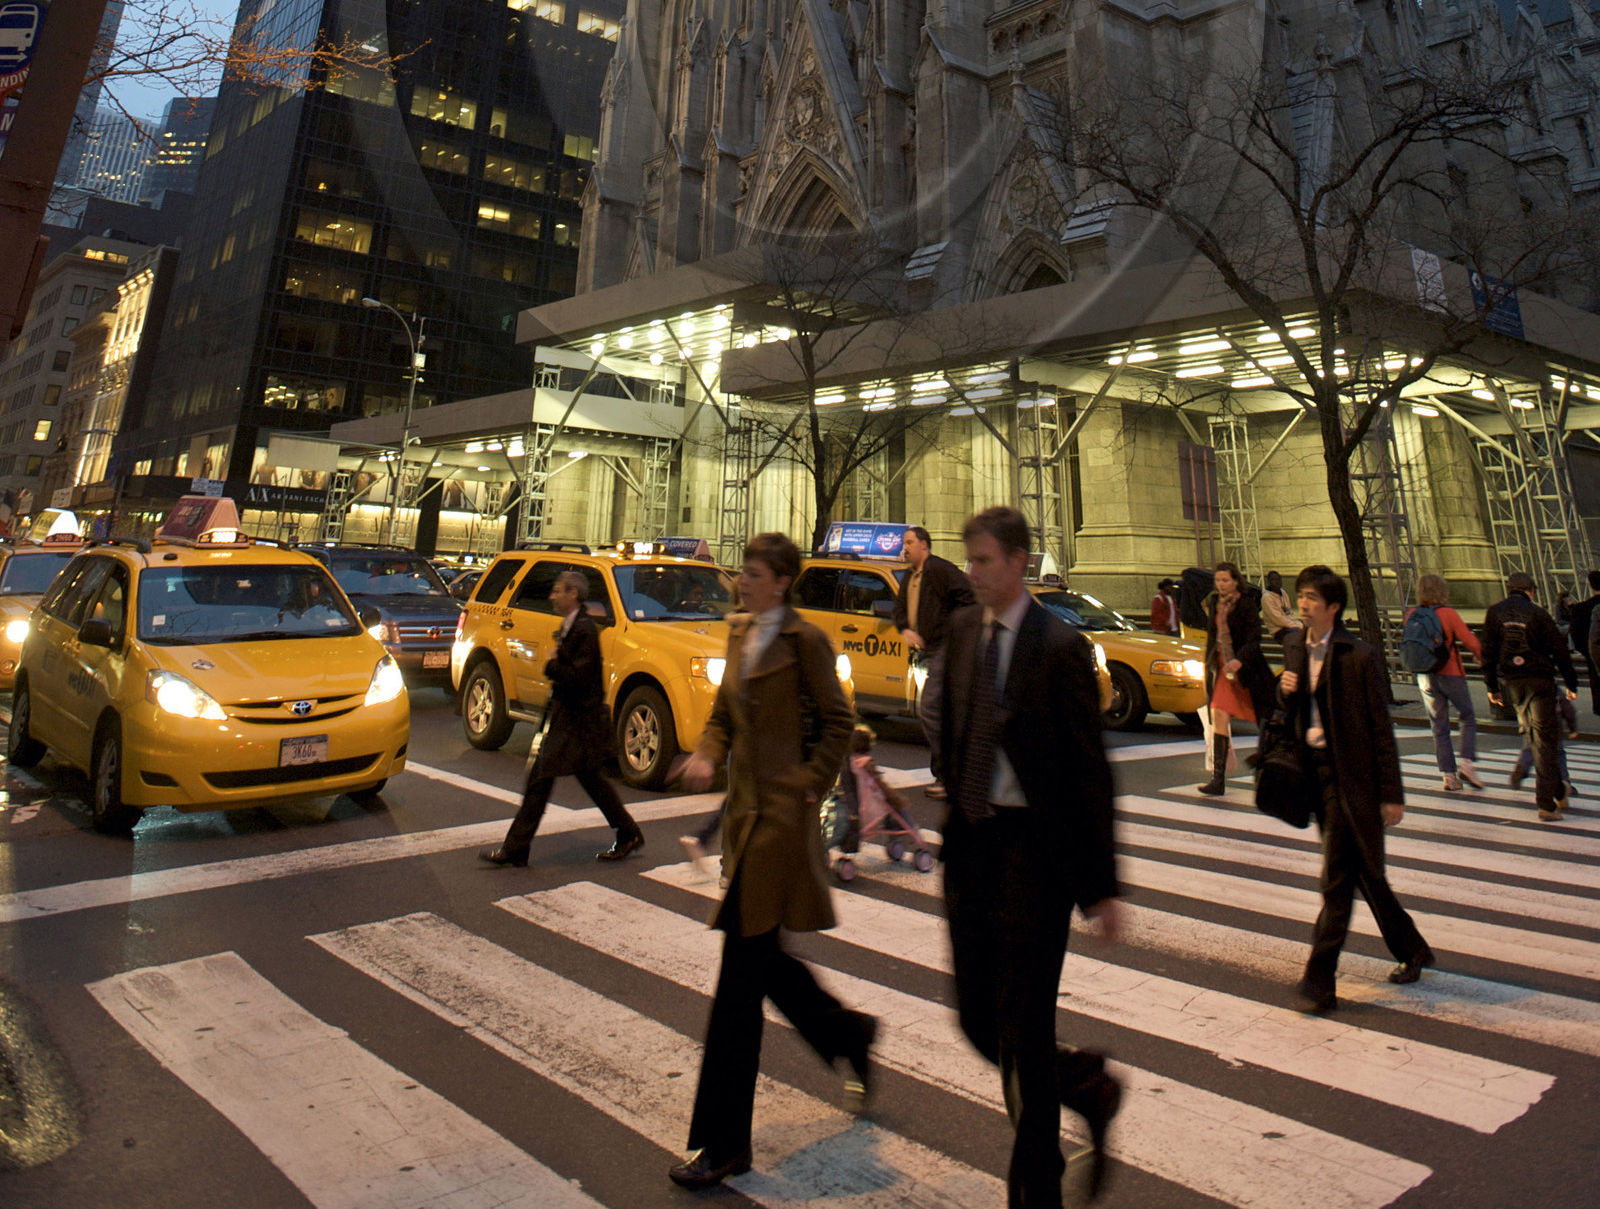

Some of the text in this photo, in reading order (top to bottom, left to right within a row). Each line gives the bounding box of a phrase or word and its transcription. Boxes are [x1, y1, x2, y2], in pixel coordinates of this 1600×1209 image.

[669, 540, 698, 548] COVERED
[843, 634, 902, 657] NYC TAXI
